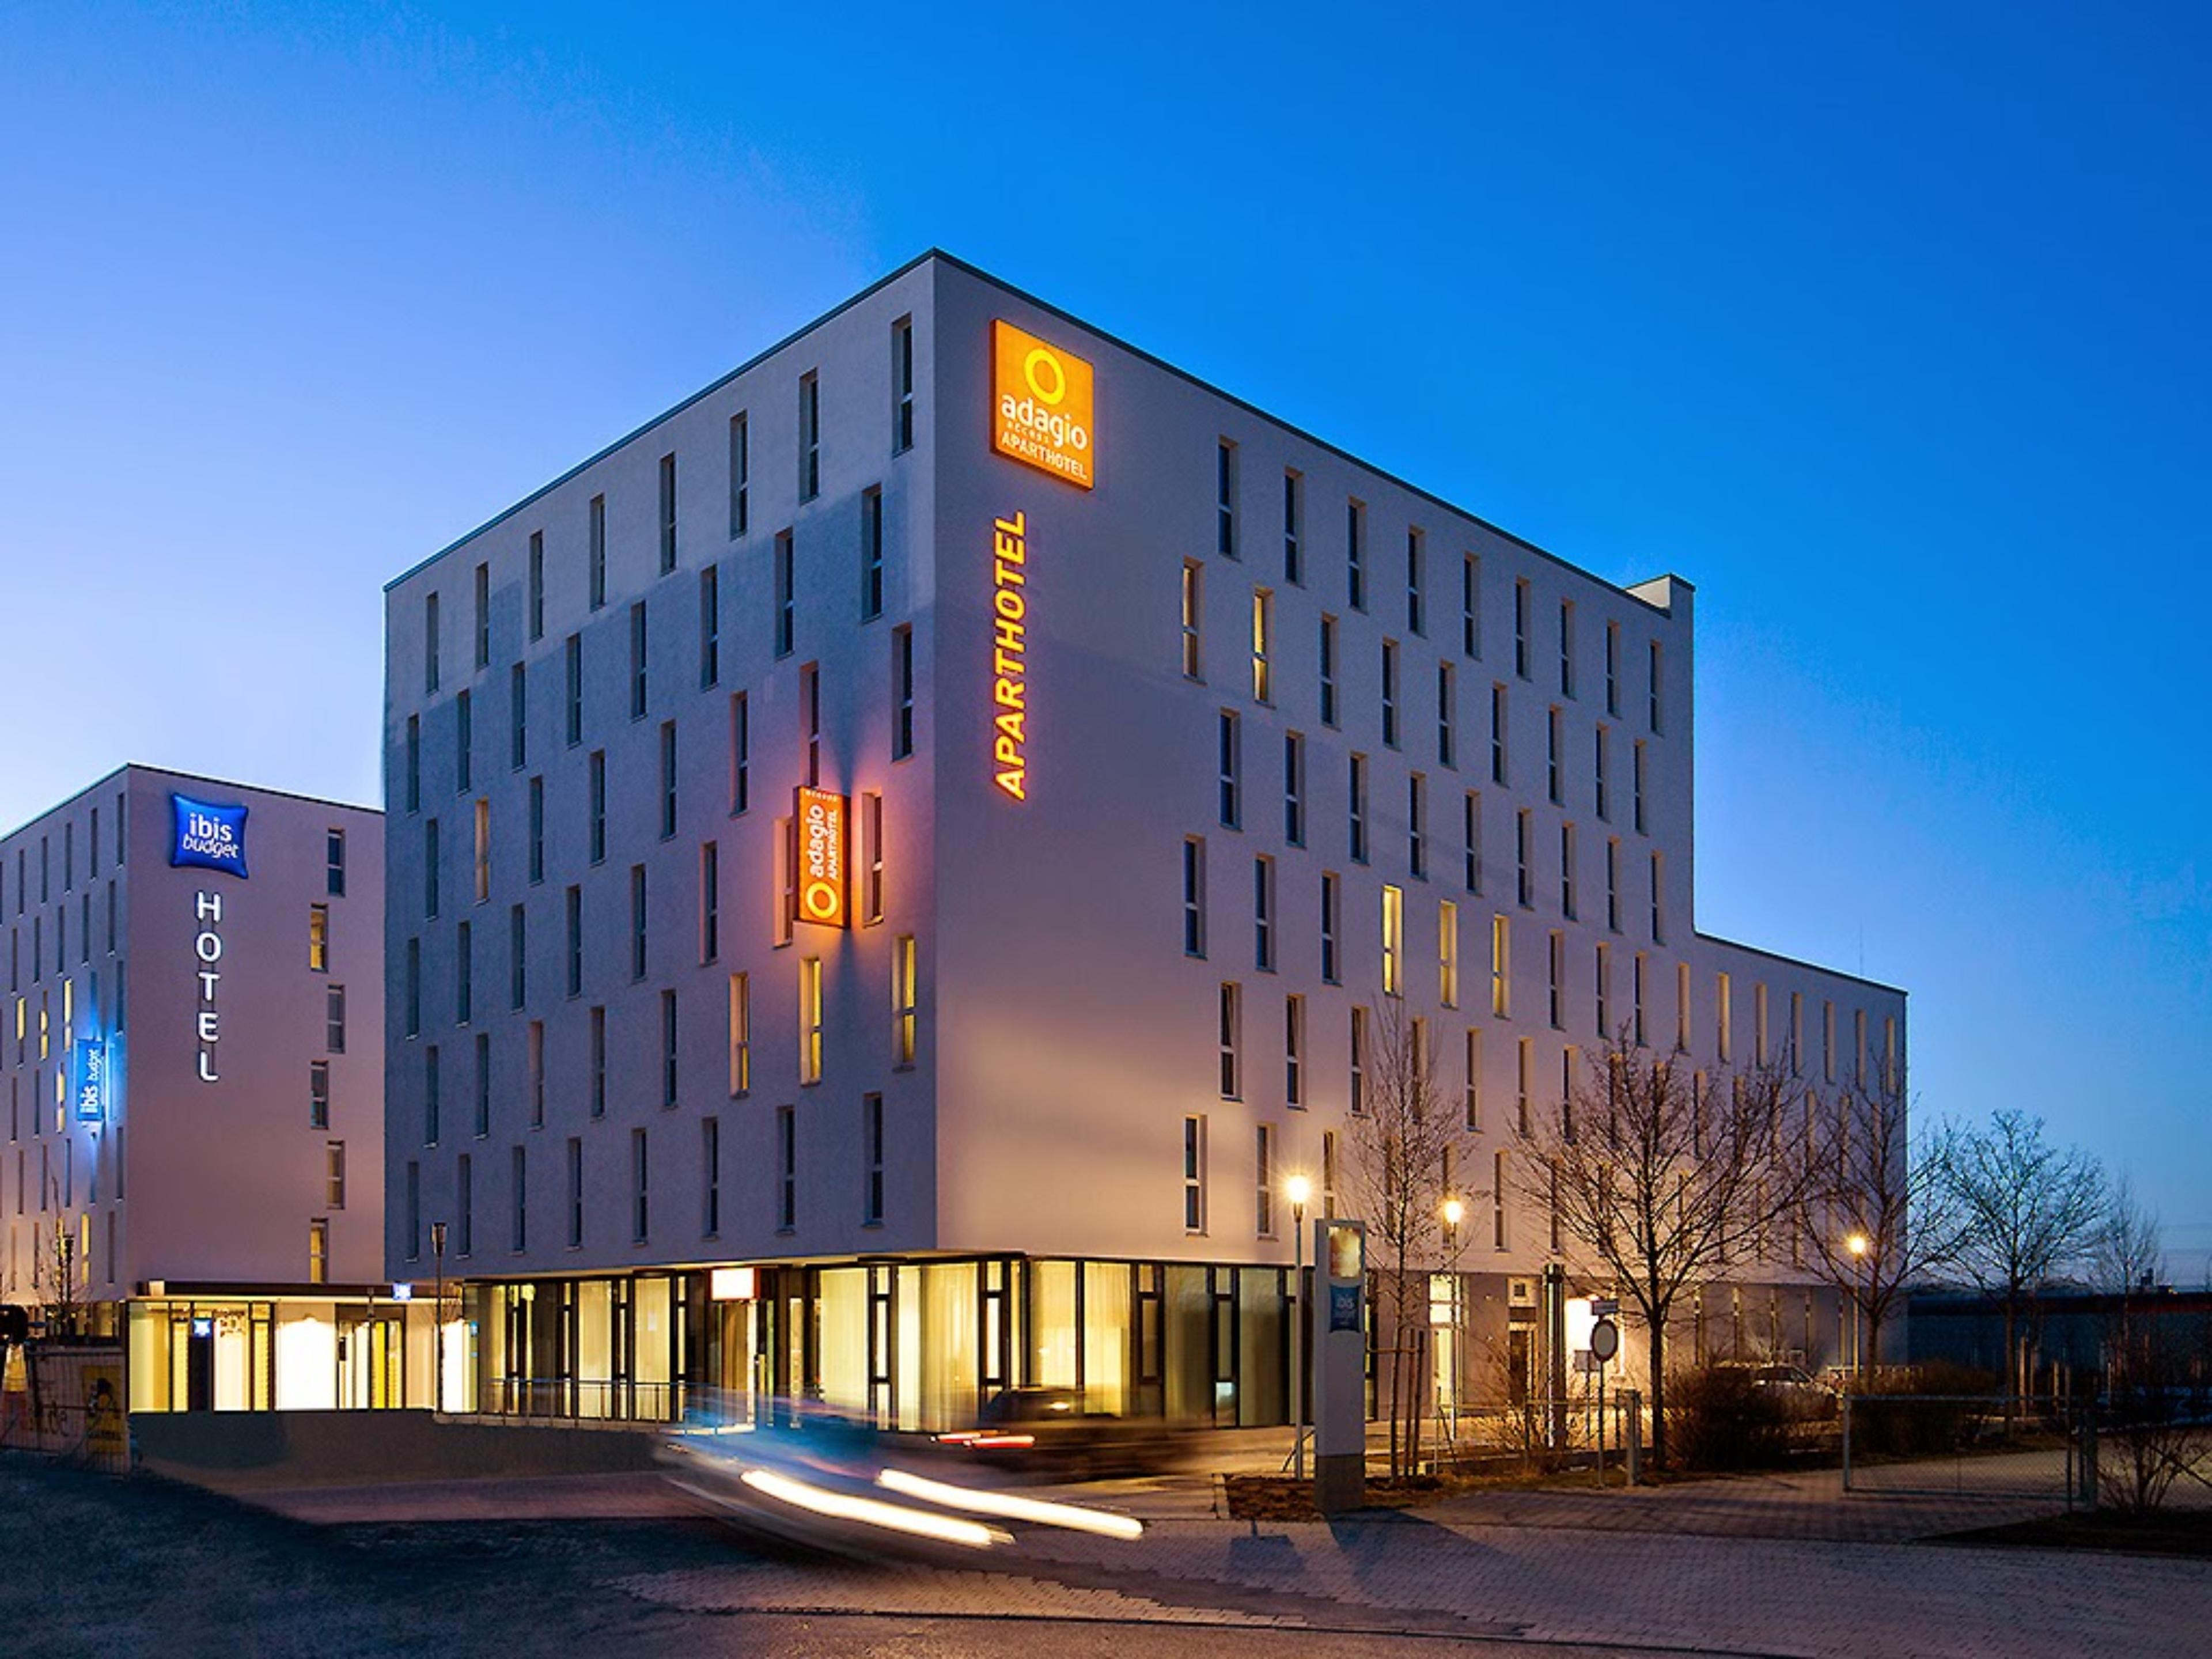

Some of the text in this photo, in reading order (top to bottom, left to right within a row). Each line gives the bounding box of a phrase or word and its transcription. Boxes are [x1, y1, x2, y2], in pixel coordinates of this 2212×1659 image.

[1001, 394, 1088, 450] adagio
[1002, 431, 1088, 480] APARTHOTEL
[994, 510, 1026, 800] APARTHOTEL
[183, 833, 239, 858] budget
[189, 812, 232, 842] ibis
[805, 805, 828, 878] adagio
[196, 891, 222, 1081] HOTEL
